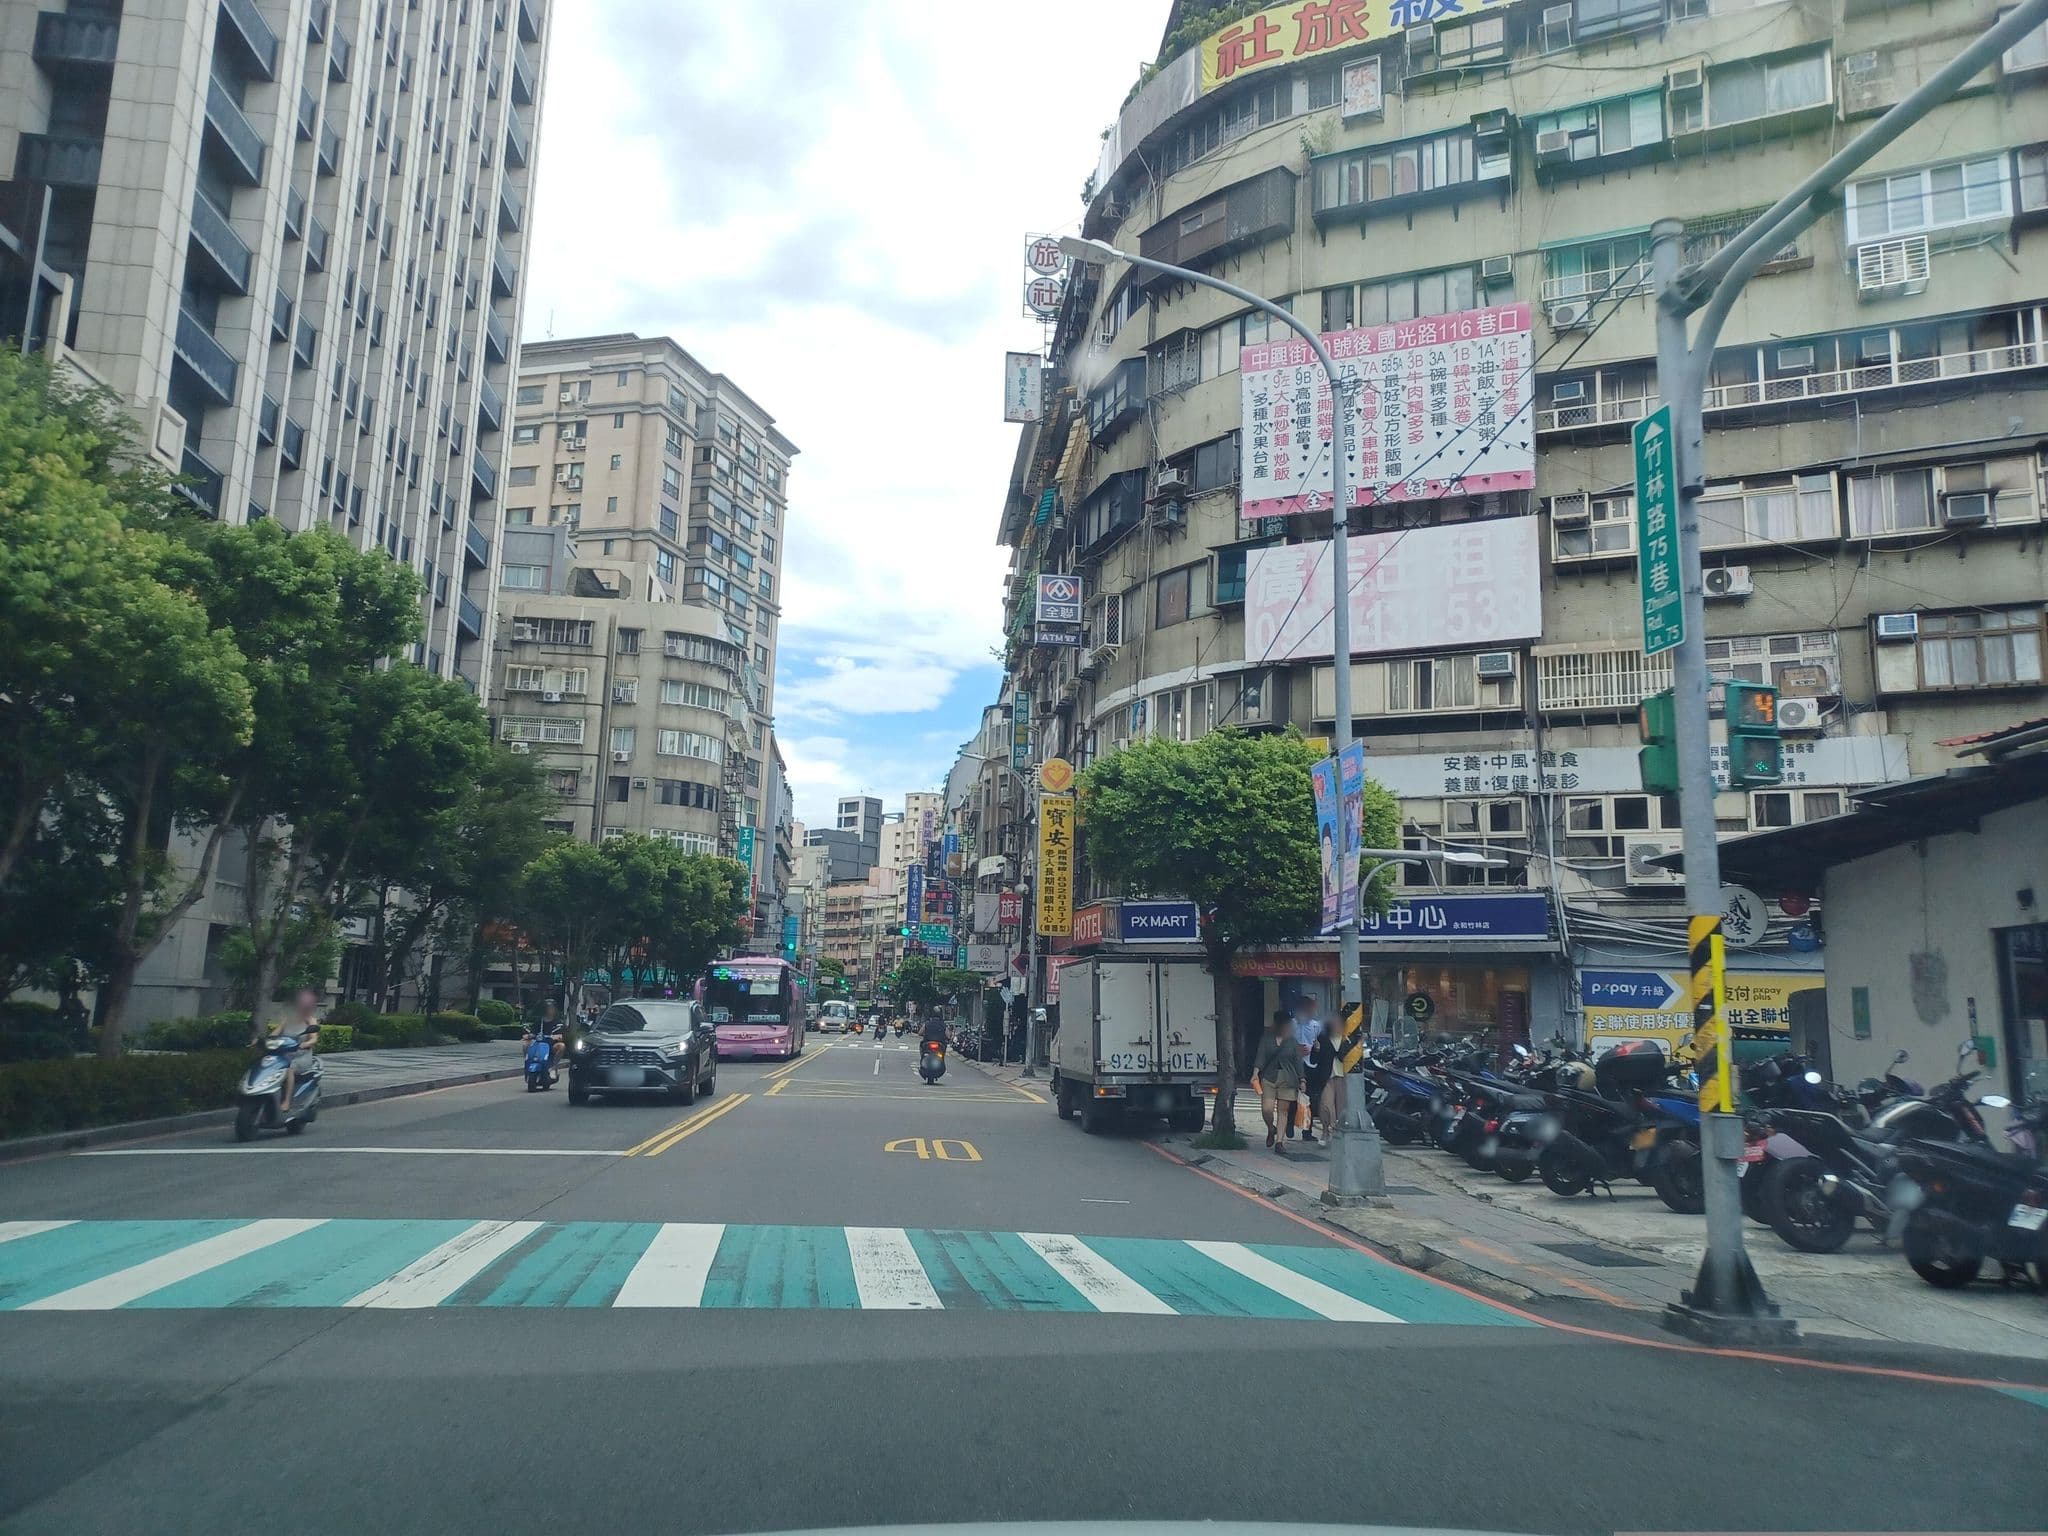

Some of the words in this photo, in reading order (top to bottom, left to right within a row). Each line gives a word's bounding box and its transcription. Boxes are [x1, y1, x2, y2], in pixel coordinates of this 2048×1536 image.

[1429, 351, 1446, 367] 3A
[1453, 347, 1470, 362] 1B
[1478, 344, 1494, 359] 1A
[1362, 361, 1378, 376] 7A
[1407, 354, 1424, 370] 3B
[1295, 370, 1312, 386] 9B
[1339, 364, 1356, 380] 7B
[1643, 444, 1671, 592] 竹林路75巷
[1046, 606, 1074, 618] 全聯
[1041, 634, 1063, 642] ATM
[1665, 624, 1680, 641] 75
[1073, 912, 1103, 942] HOTEL
[1131, 916, 1148, 927] PX
[1150, 915, 1188, 927] MART
[1641, 985, 1665, 997] 升級
[884, 1137, 983, 1162] 40
